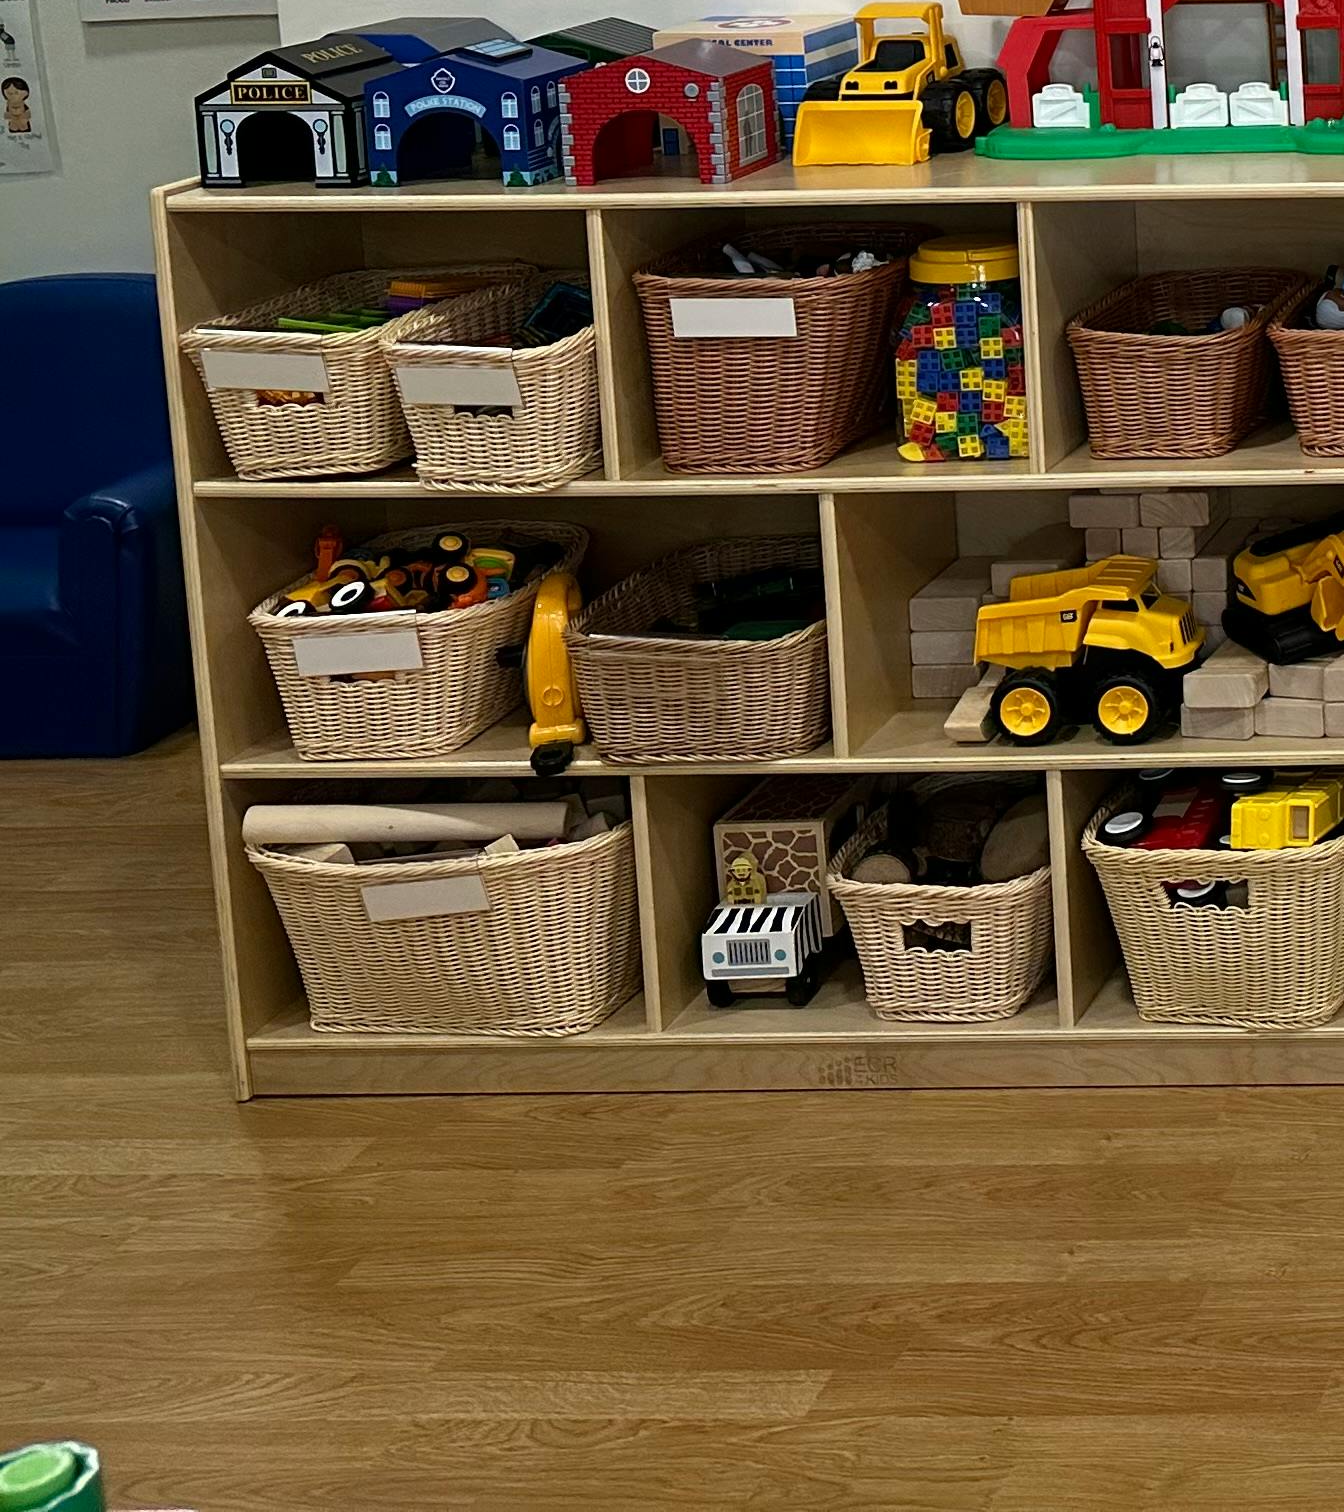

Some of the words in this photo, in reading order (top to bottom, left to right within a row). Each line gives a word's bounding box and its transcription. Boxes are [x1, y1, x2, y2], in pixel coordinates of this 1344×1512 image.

[734, 39, 773, 47] CENTER
[301, 43, 364, 64] POLICE
[237, 86, 306, 100] POLICE
[442, 96, 482, 114] STATION
